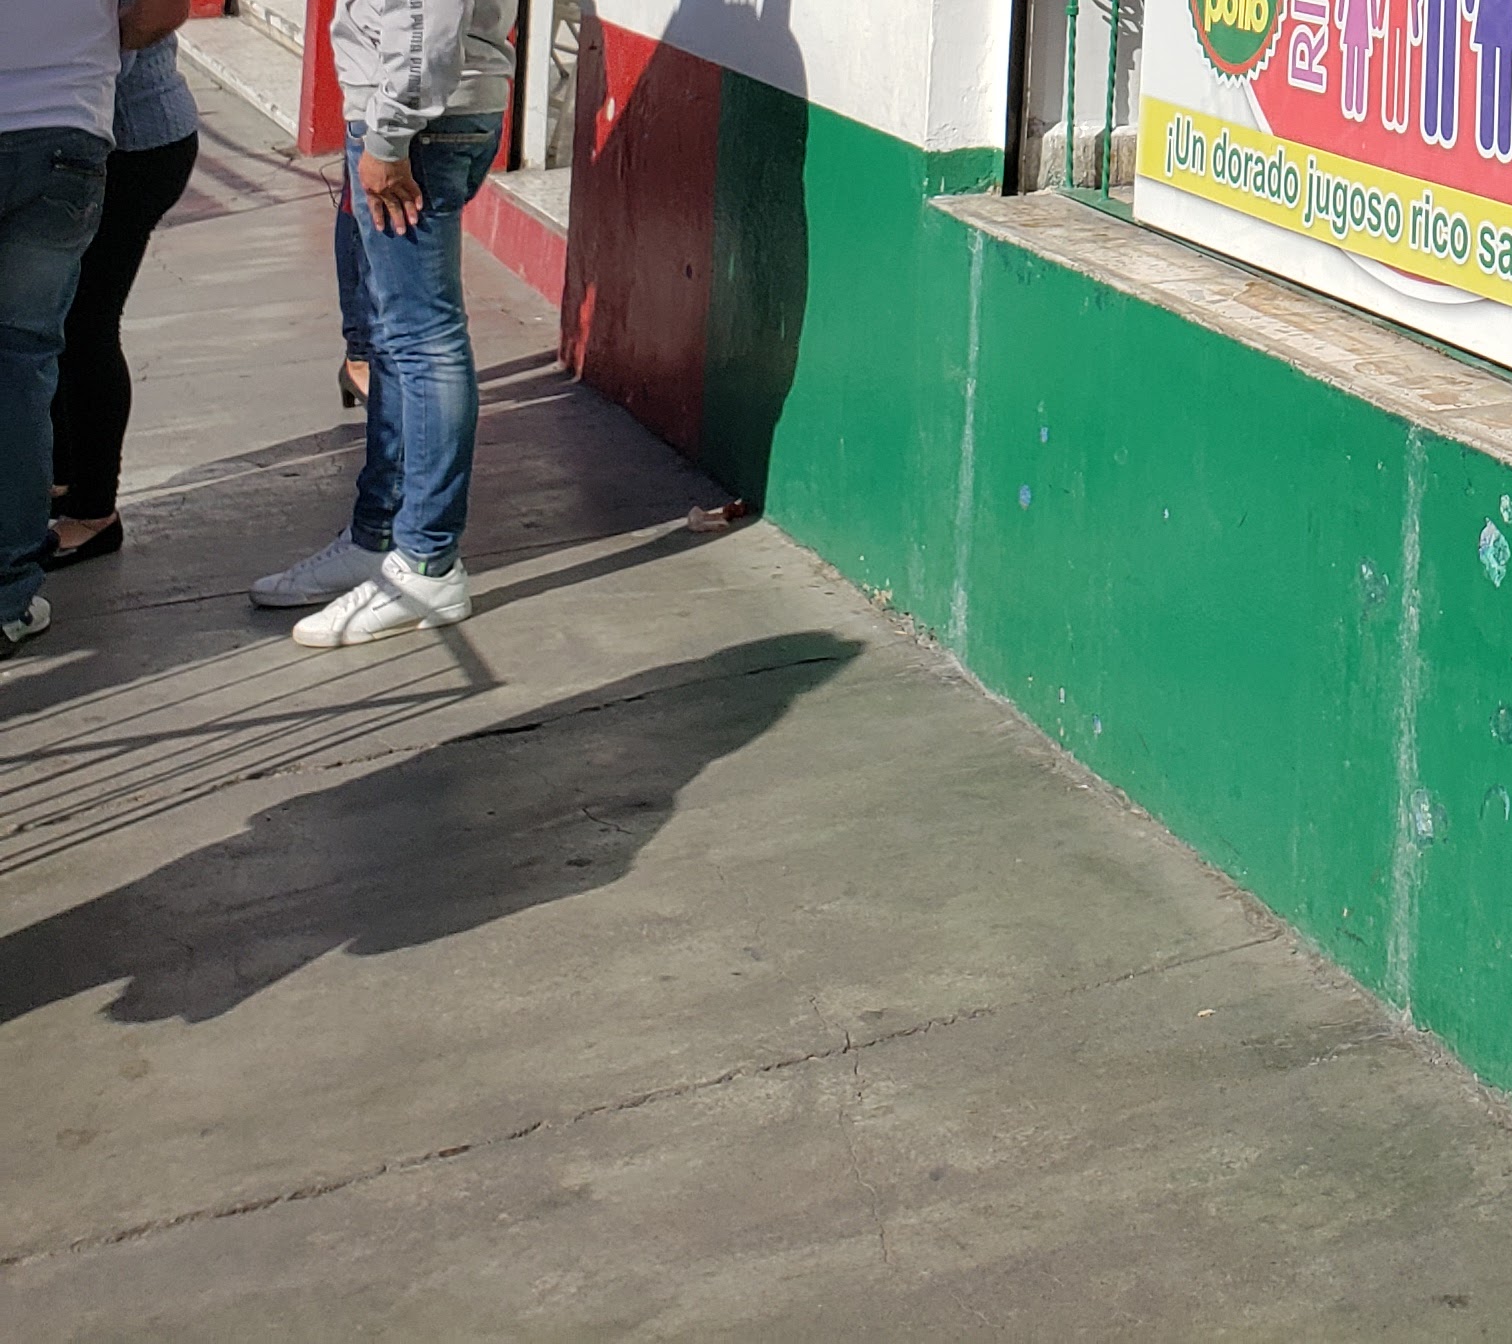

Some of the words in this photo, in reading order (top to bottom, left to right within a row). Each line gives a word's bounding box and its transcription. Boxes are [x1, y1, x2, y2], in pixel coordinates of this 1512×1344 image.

[1165, 113, 1208, 177] ¡Un
[1210, 130, 1301, 209] dorado
[1302, 152, 1404, 244] jugoso
[1409, 190, 1472, 263] rico
